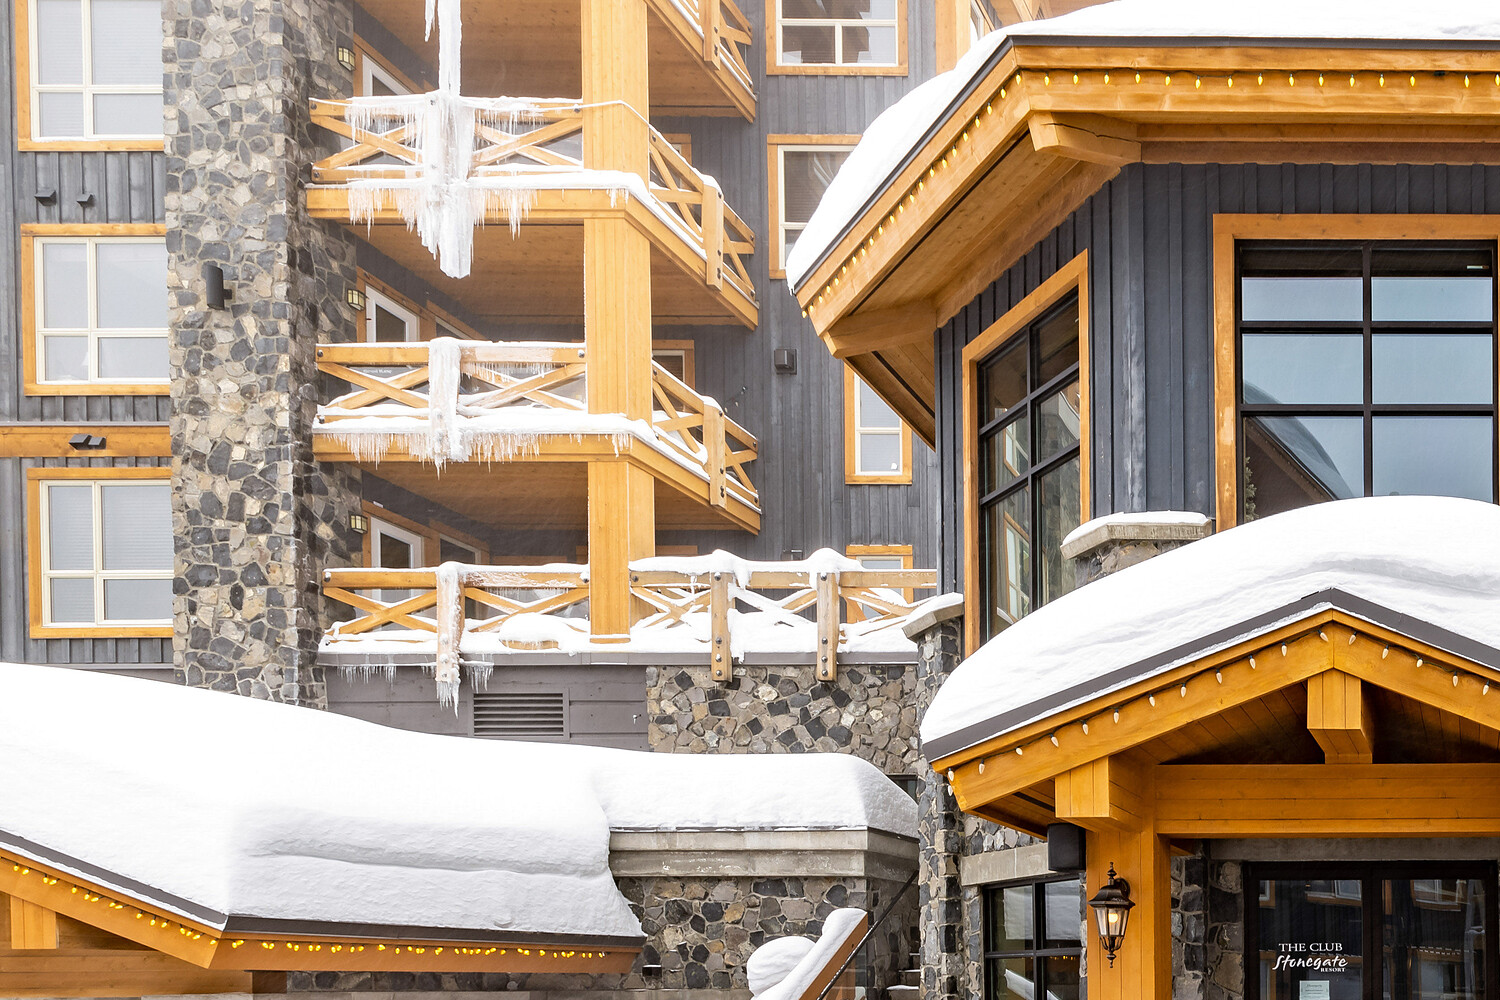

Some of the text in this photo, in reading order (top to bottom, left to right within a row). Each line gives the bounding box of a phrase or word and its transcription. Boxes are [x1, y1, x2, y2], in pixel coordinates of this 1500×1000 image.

[1278, 943, 1343, 952] THE CLUB
[1272, 954, 1348, 971] Stonegate
